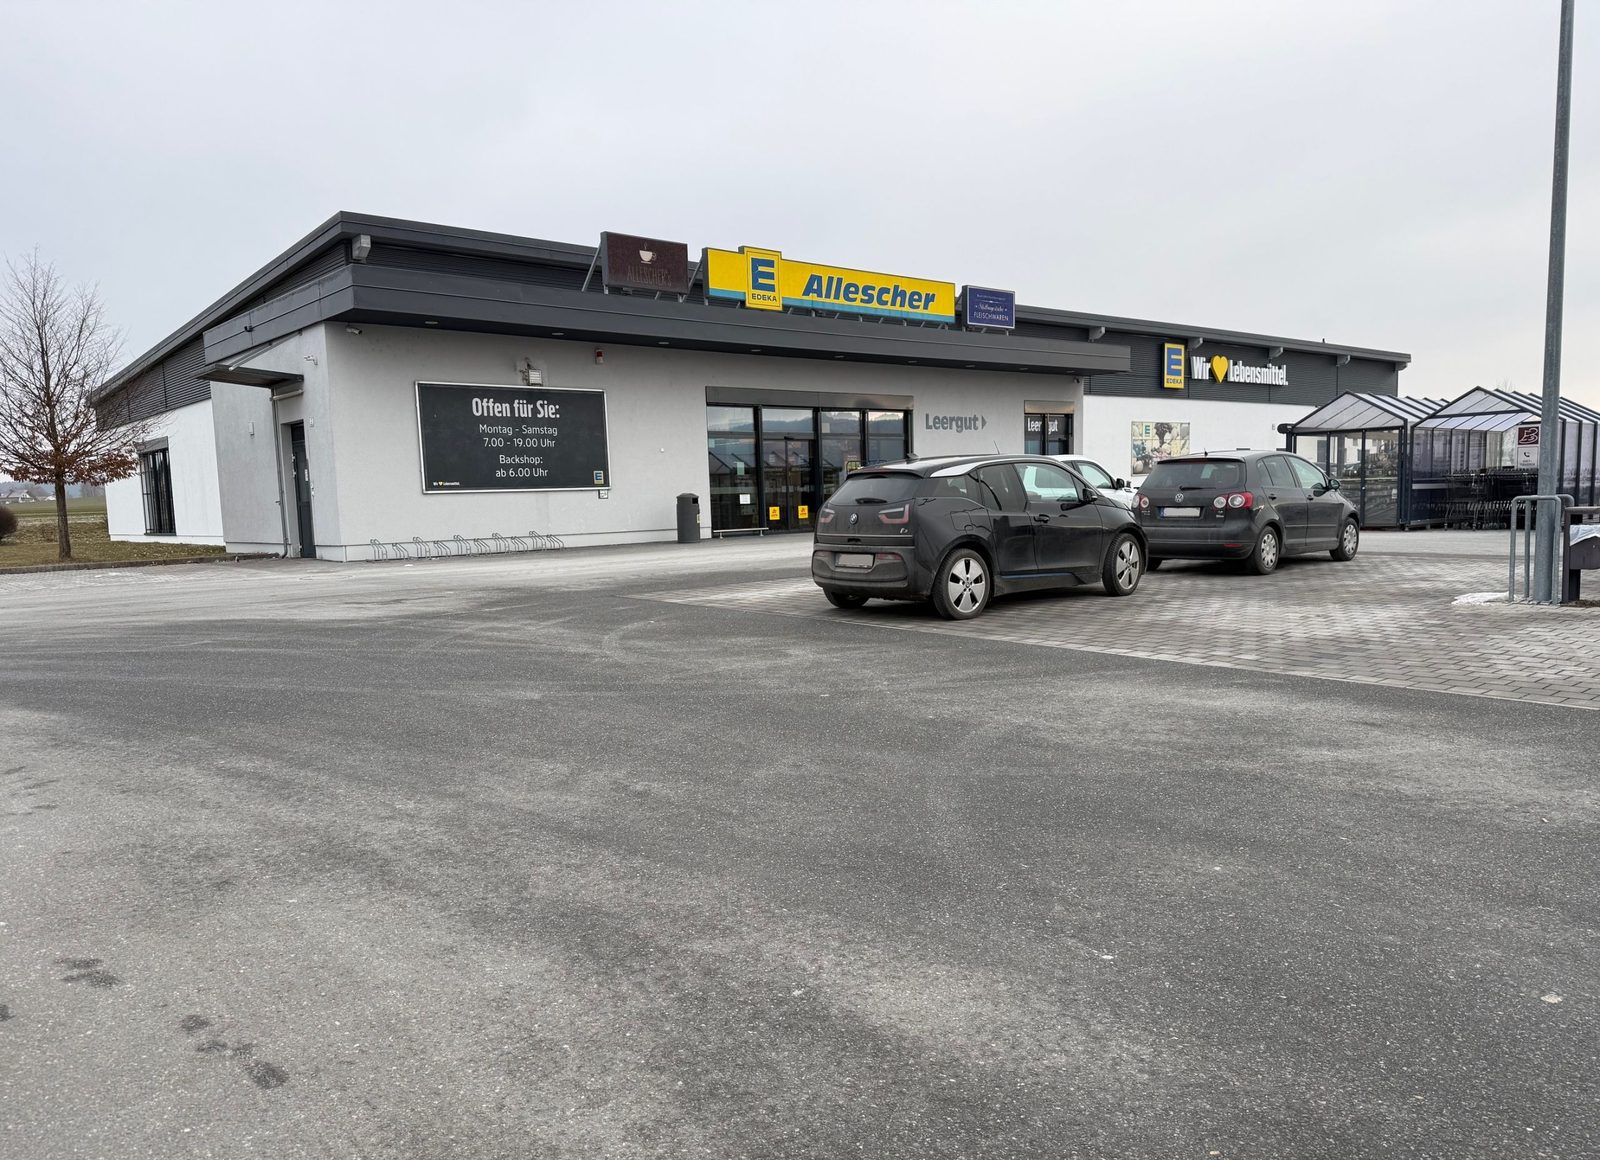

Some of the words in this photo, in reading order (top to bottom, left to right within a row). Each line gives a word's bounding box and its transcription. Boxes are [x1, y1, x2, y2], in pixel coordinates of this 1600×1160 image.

[751, 257, 775, 292] E
[752, 293, 777, 302] EDEKA
[802, 273, 936, 310] Allescher
[1167, 348, 1182, 376] E
[1190, 356, 1211, 380] Wir
[1228, 359, 1289, 386] Lebensmittel.
[472, 397, 511, 417] Offen
[513, 399, 534, 418] für
[536, 400, 560, 418] Sie:
[479, 424, 513, 436] Montag
[521, 425, 558, 436] Samstag
[925, 413, 979, 433] Leergut
[483, 437, 504, 447] 7.00
[513, 438, 538, 448] 19.00
[540, 438, 556, 448] Uhr
[499, 454, 543, 466] Backshop:
[495, 468, 507, 477] ab
[509, 467, 531, 477] 6.00
[532, 467, 549, 477] Uhr
